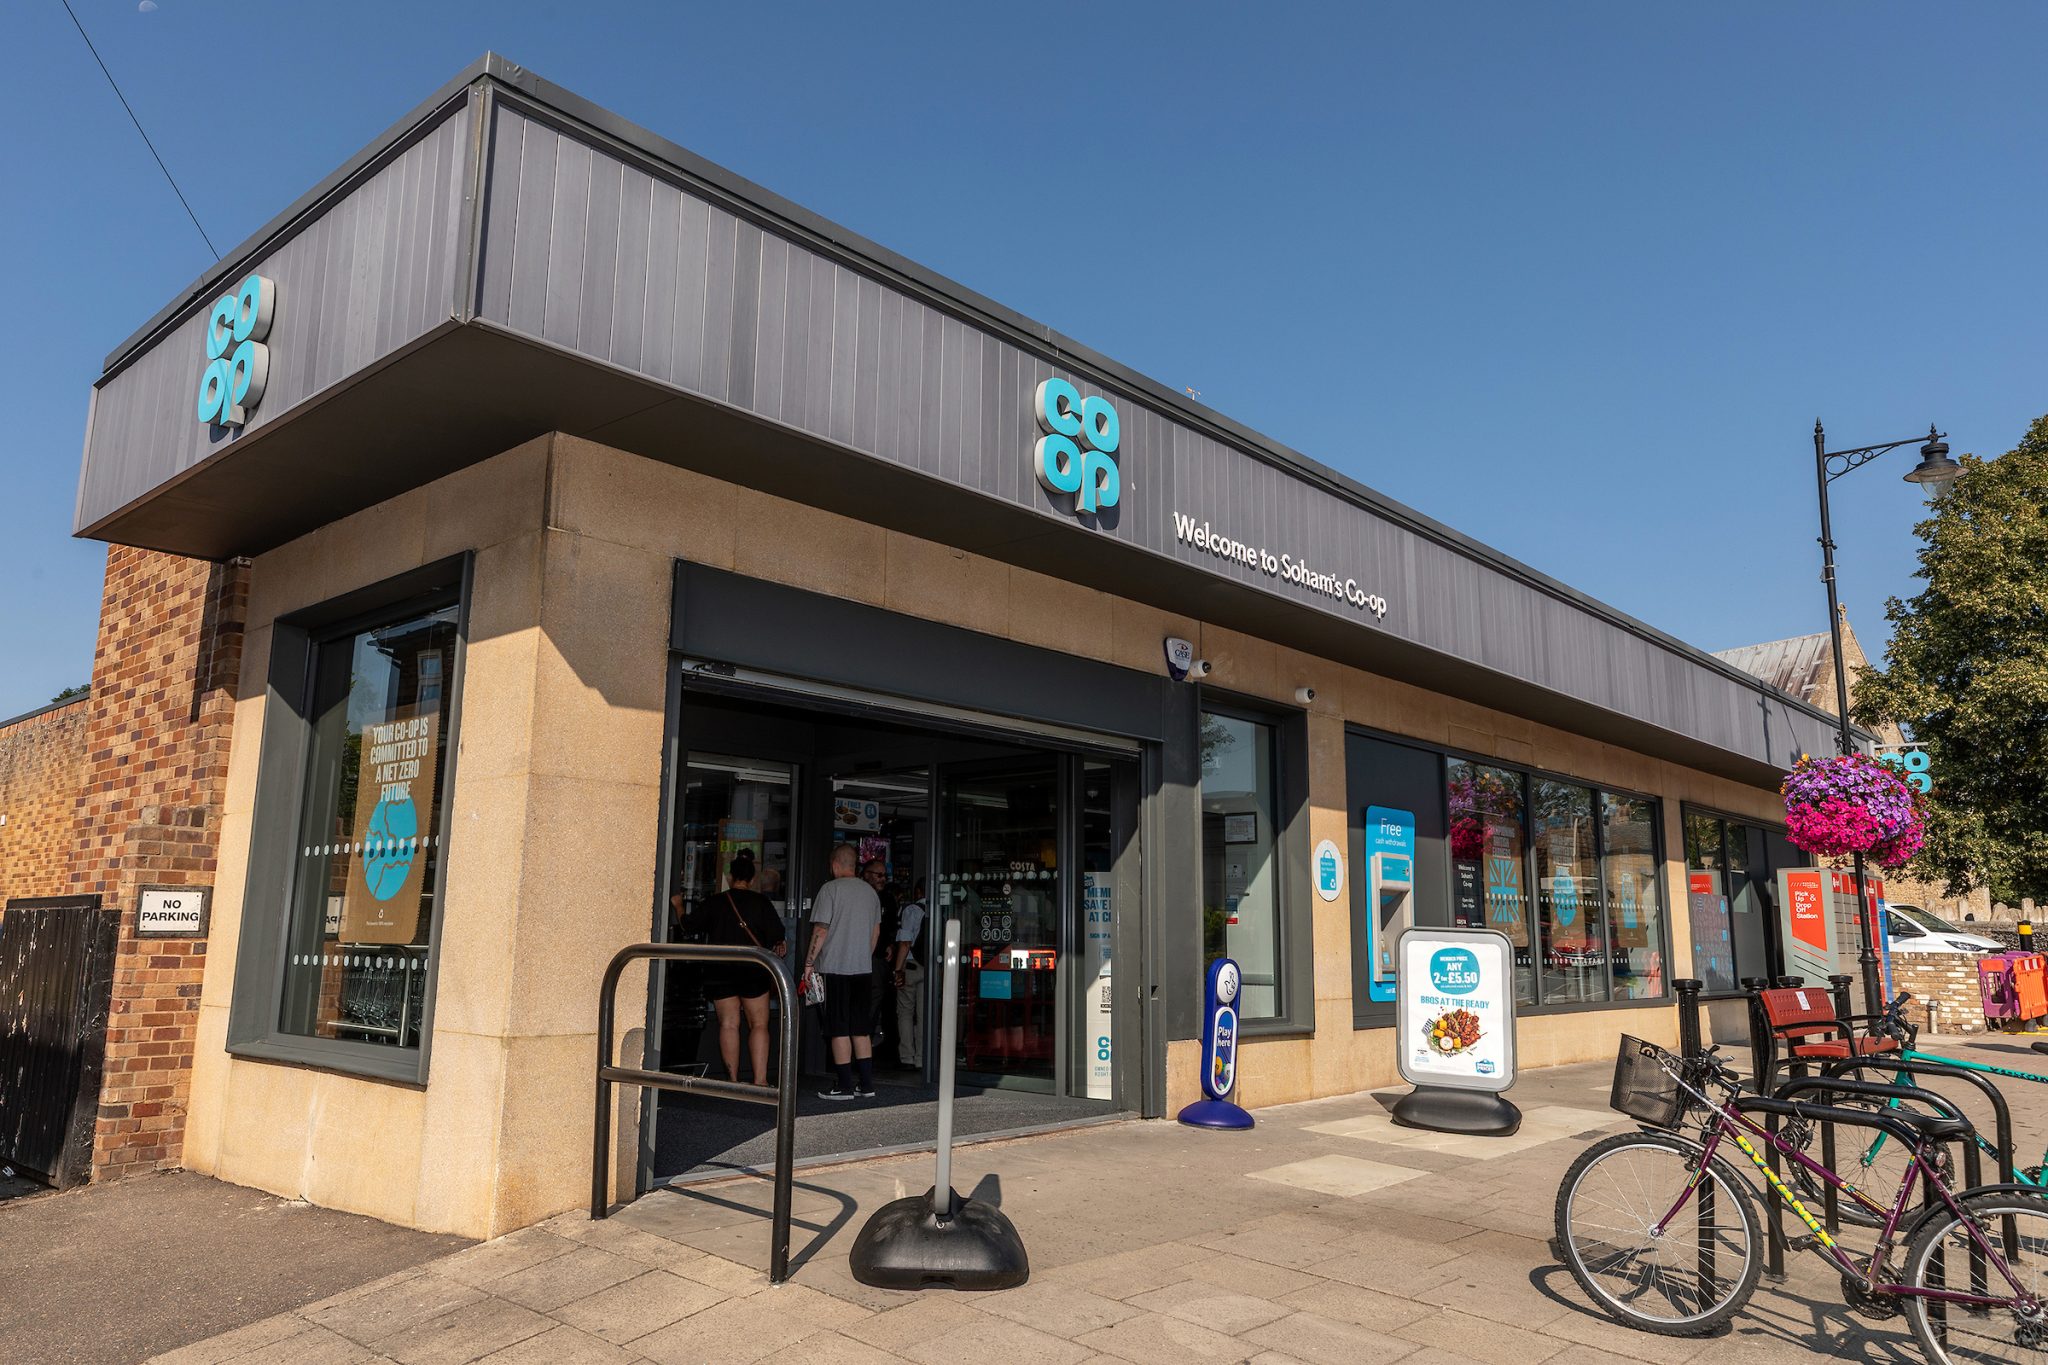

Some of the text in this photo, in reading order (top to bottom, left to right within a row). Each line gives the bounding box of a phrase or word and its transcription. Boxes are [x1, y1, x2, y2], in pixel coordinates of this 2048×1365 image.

[1174, 511, 1387, 618] Welcome to Soham's Co-op
[373, 716, 428, 745] YOUR CO-OP IS
[370, 737, 429, 764] COMMITTED TO
[375, 759, 420, 783] A NET ZERO
[380, 780, 411, 802] FUTURE
[1380, 817, 1402, 837] Free
[1385, 838, 1407, 848] withdrawals
[1010, 861, 1035, 872] COSTA
[162, 899, 182, 909] NO
[1084, 899, 1108, 910] SAVE
[142, 912, 199, 921] PARKING
[1089, 911, 1100, 922] AT
[1446, 962, 1462, 971] ANY
[1433, 972, 1441, 984] 2
[1448, 971, 1478, 984] £5.50
[1420, 996, 1490, 1009] BBQS AT THE READY
[1218, 1026, 1232, 1038] Play
[1217, 1037, 1231, 1047] here
